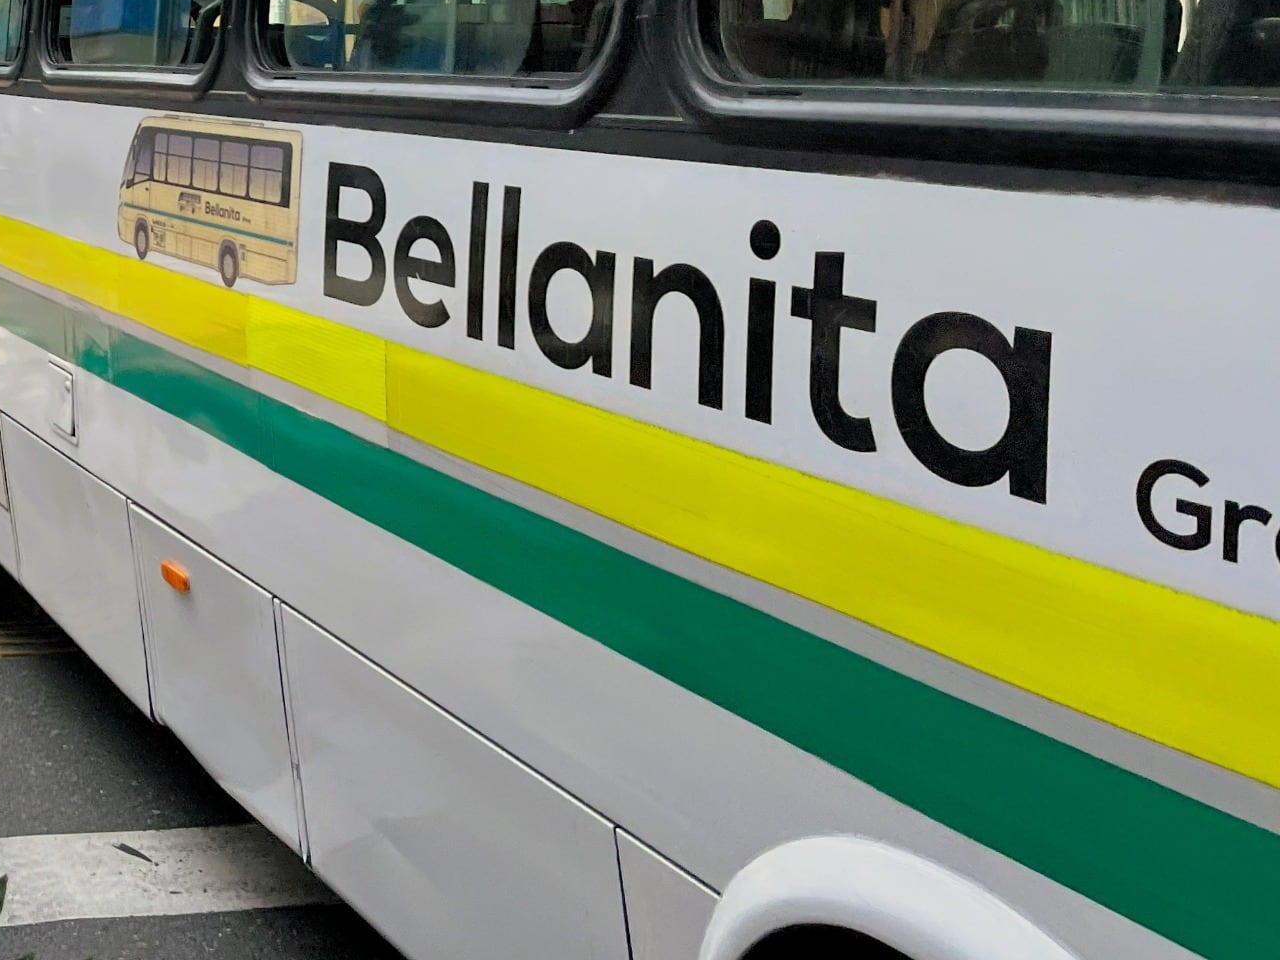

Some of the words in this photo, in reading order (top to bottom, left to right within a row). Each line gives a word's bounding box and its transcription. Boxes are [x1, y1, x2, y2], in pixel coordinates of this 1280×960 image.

[204, 200, 241, 222] Bellanita
[323, 160, 1054, 505] Bellanita
[1135, 458, 1280, 565] Gr
